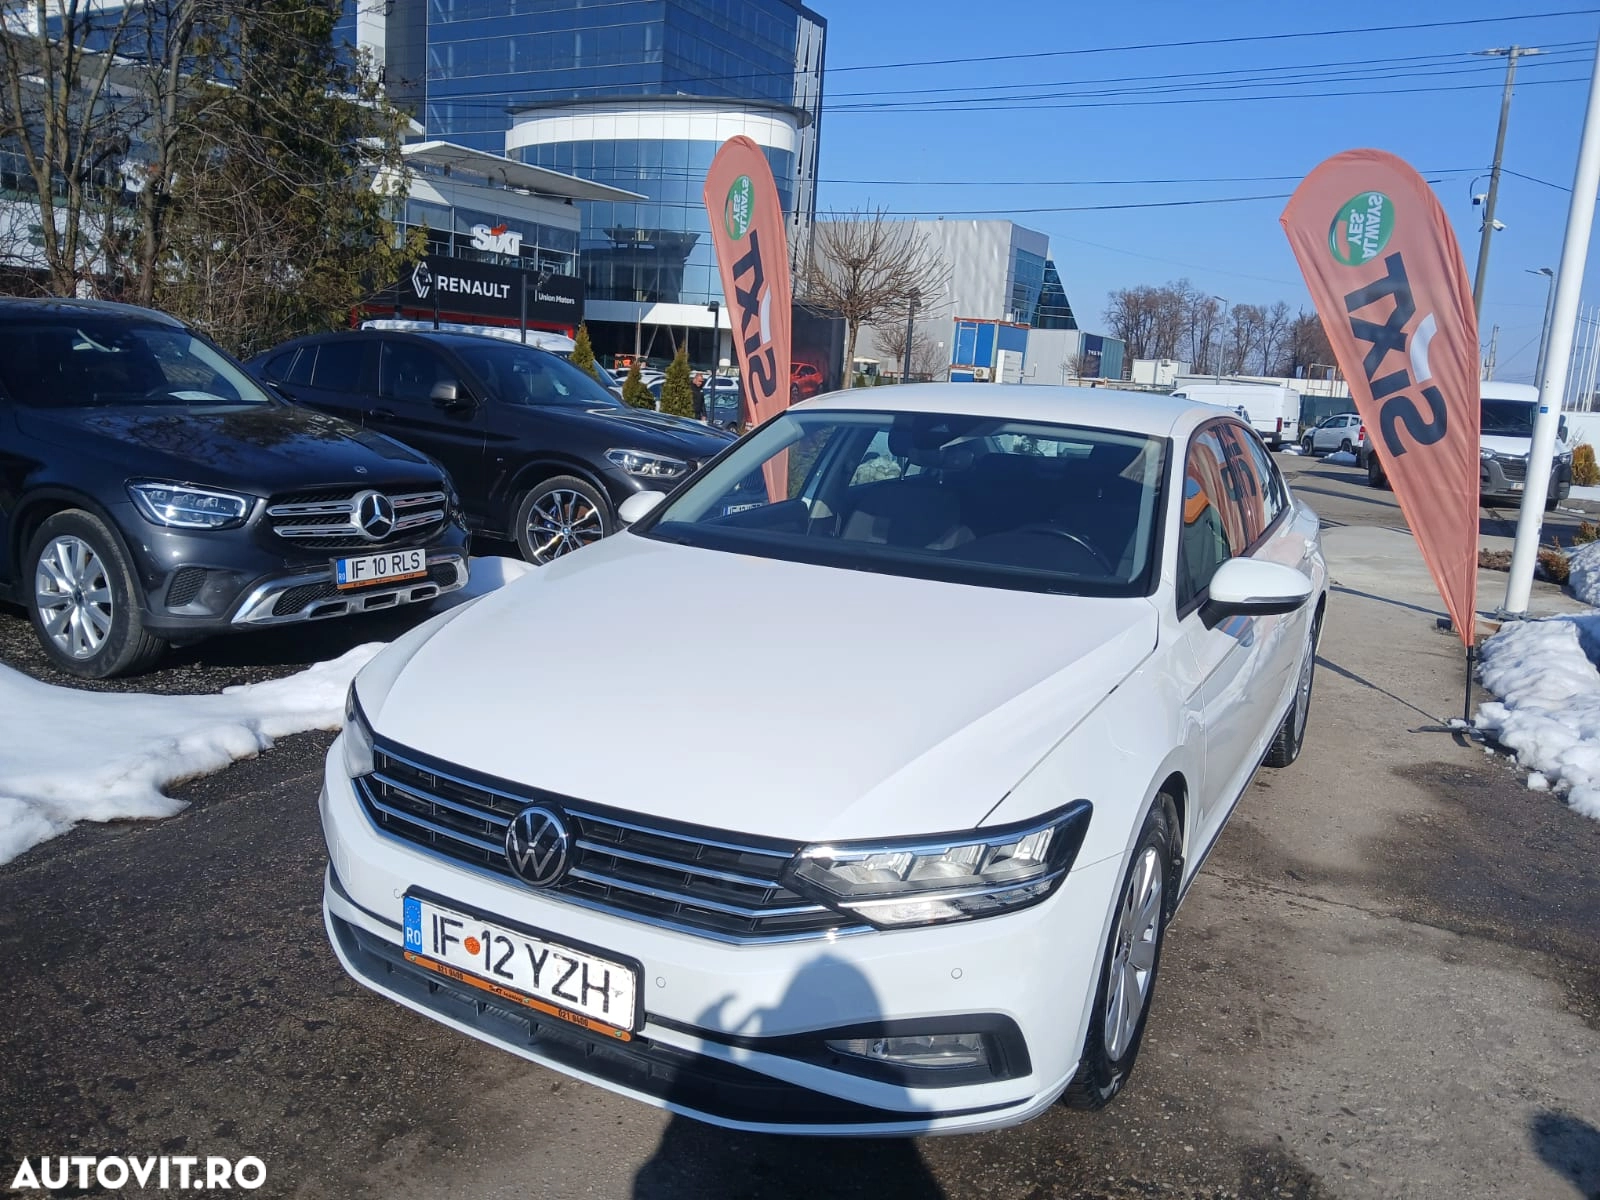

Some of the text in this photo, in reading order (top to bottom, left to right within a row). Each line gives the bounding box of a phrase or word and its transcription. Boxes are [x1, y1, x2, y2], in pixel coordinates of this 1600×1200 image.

[470, 223, 523, 256] SIXT
[437, 275, 510, 299] RENAULT
[538, 292, 575, 305] Union Motors
[351, 552, 421, 579] IF 10 RLS
[406, 927, 422, 946] RO
[431, 913, 610, 1014] IF 12 YZH
